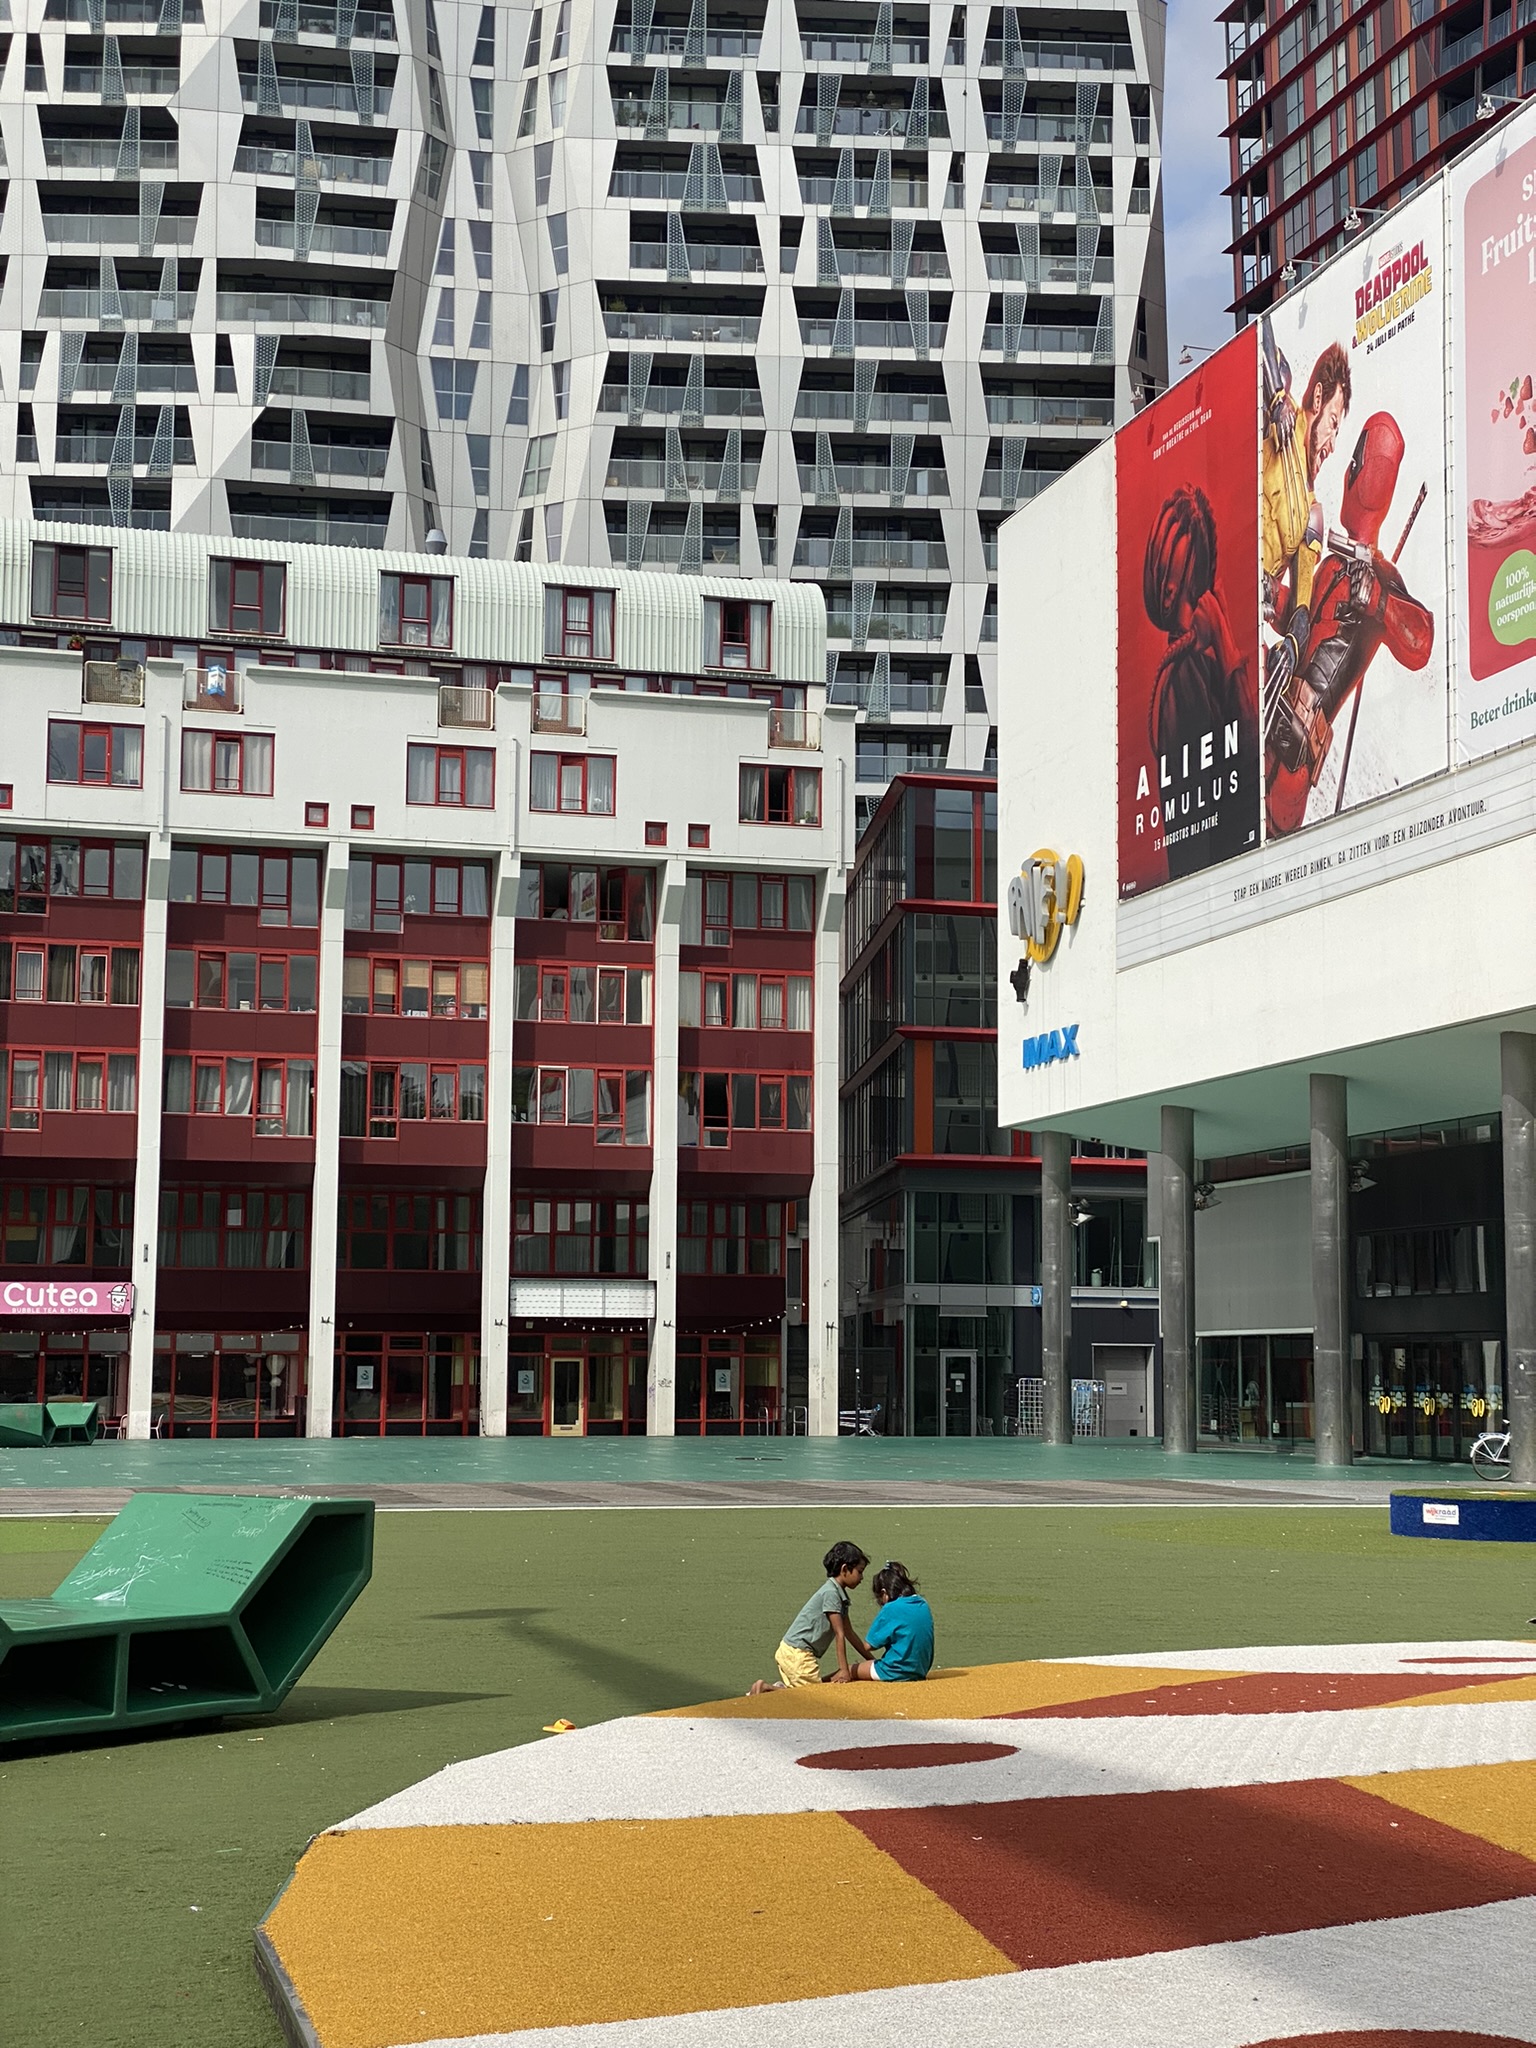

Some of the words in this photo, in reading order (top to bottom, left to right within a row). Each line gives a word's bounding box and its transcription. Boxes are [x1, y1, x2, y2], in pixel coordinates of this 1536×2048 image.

[1354, 239, 1428, 320] DEADPOOL
[1356, 265, 1433, 345] WOLVERINE
[1366, 342, 1374, 355] 24
[1375, 332, 1387, 349] JULI
[1397, 310, 1415, 333] PATHÉ
[1505, 565, 1530, 589] 100%
[1470, 706, 1501, 730] Beter
[1136, 720, 1239, 800] ALIEN
[1135, 770, 1239, 836] ROMULUS
[1153, 838, 1161, 852] 15
[1162, 826, 1190, 848] AUGUSTUS
[1190, 822, 1200, 836] BIJ
[1201, 811, 1219, 831] PATHÉ
[1233, 887, 1247, 902] STAP
[1249, 883, 1260, 896] EEN
[1261, 873, 1282, 892] ANDERE
[1284, 864, 1308, 883] WERELD
[1338, 850, 1347, 864] GA
[1349, 841, 1371, 860] ZITTEN
[1374, 834, 1390, 851] VOOR
[1393, 828, 1406, 844] EEN
[1409, 814, 1445, 839] BIJZONDER
[1448, 799, 1487, 824] AVONTUUR.
[3, 1282, 98, 1307] Cutea
